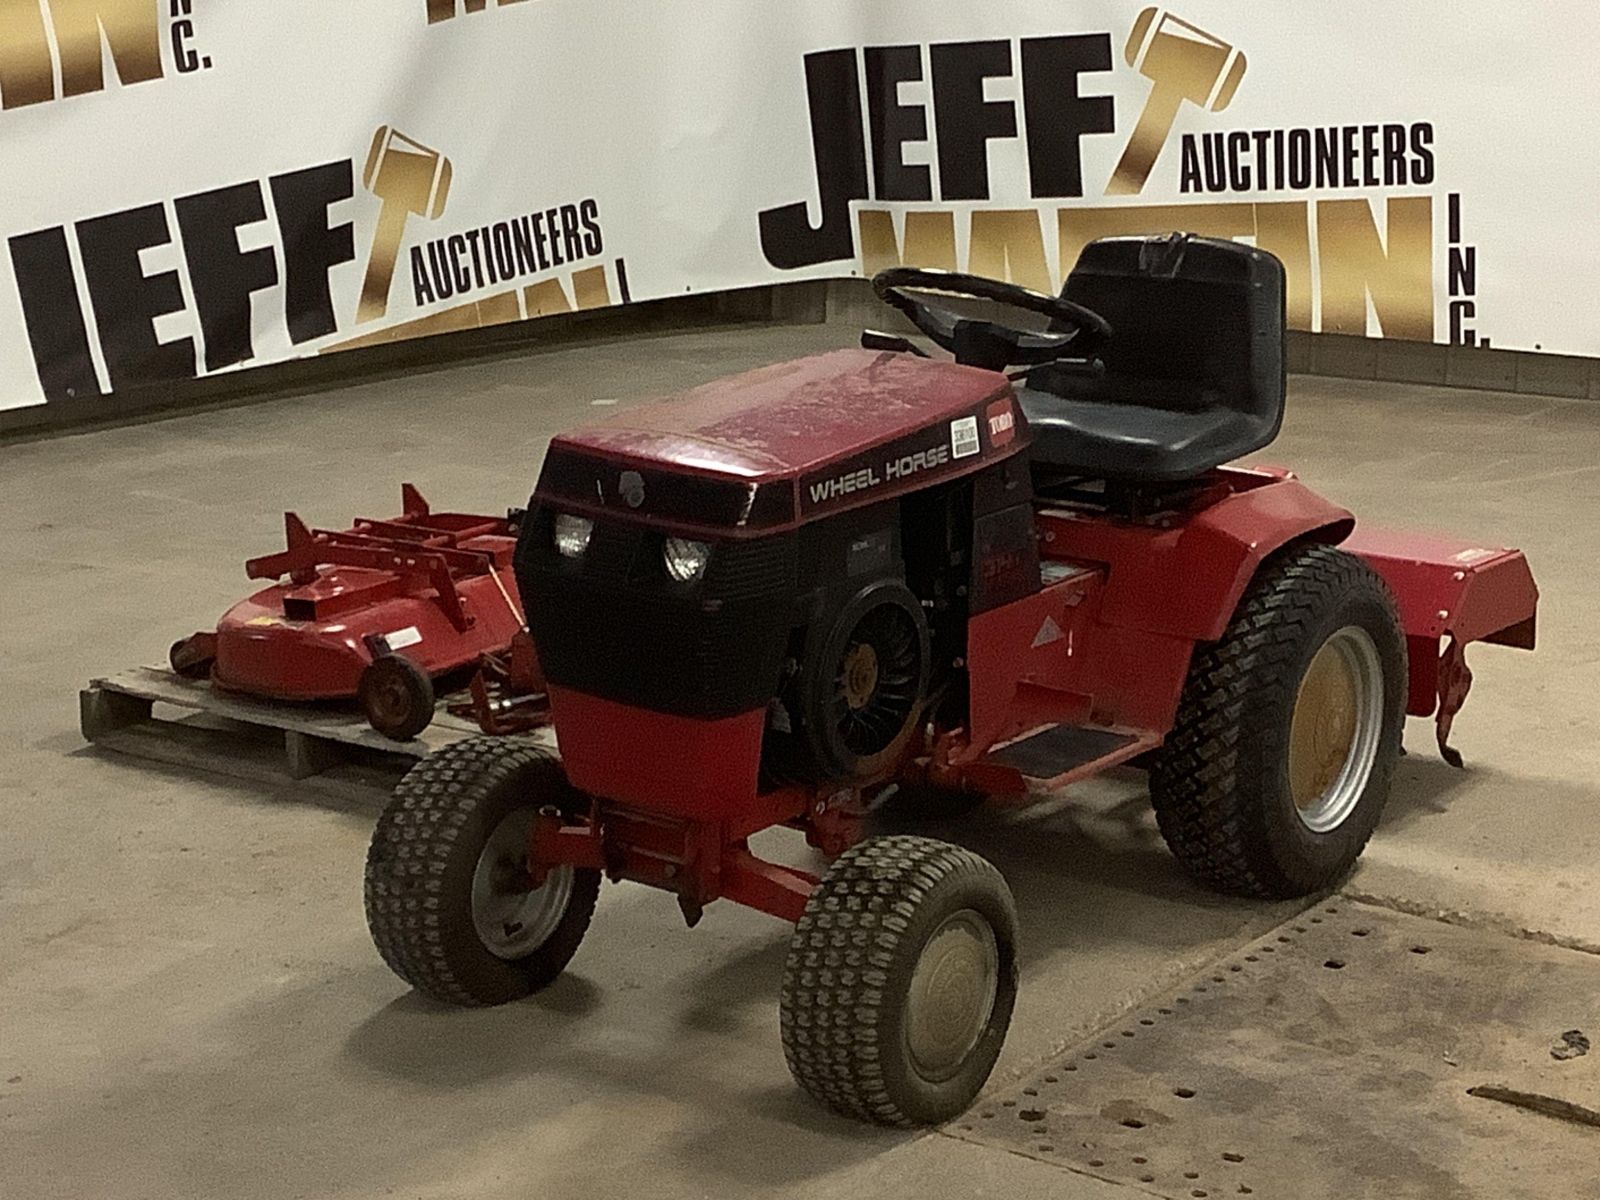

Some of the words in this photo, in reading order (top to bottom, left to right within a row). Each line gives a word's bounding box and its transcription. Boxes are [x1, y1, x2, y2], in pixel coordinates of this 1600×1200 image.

[759, 33, 1115, 269] JEFF
[1180, 123, 1434, 194] AUCTIONEERS
[410, 199, 604, 306] AUCTIONEERS
[810, 468, 880, 503] WHEEL
[886, 444, 949, 481] HORSE
